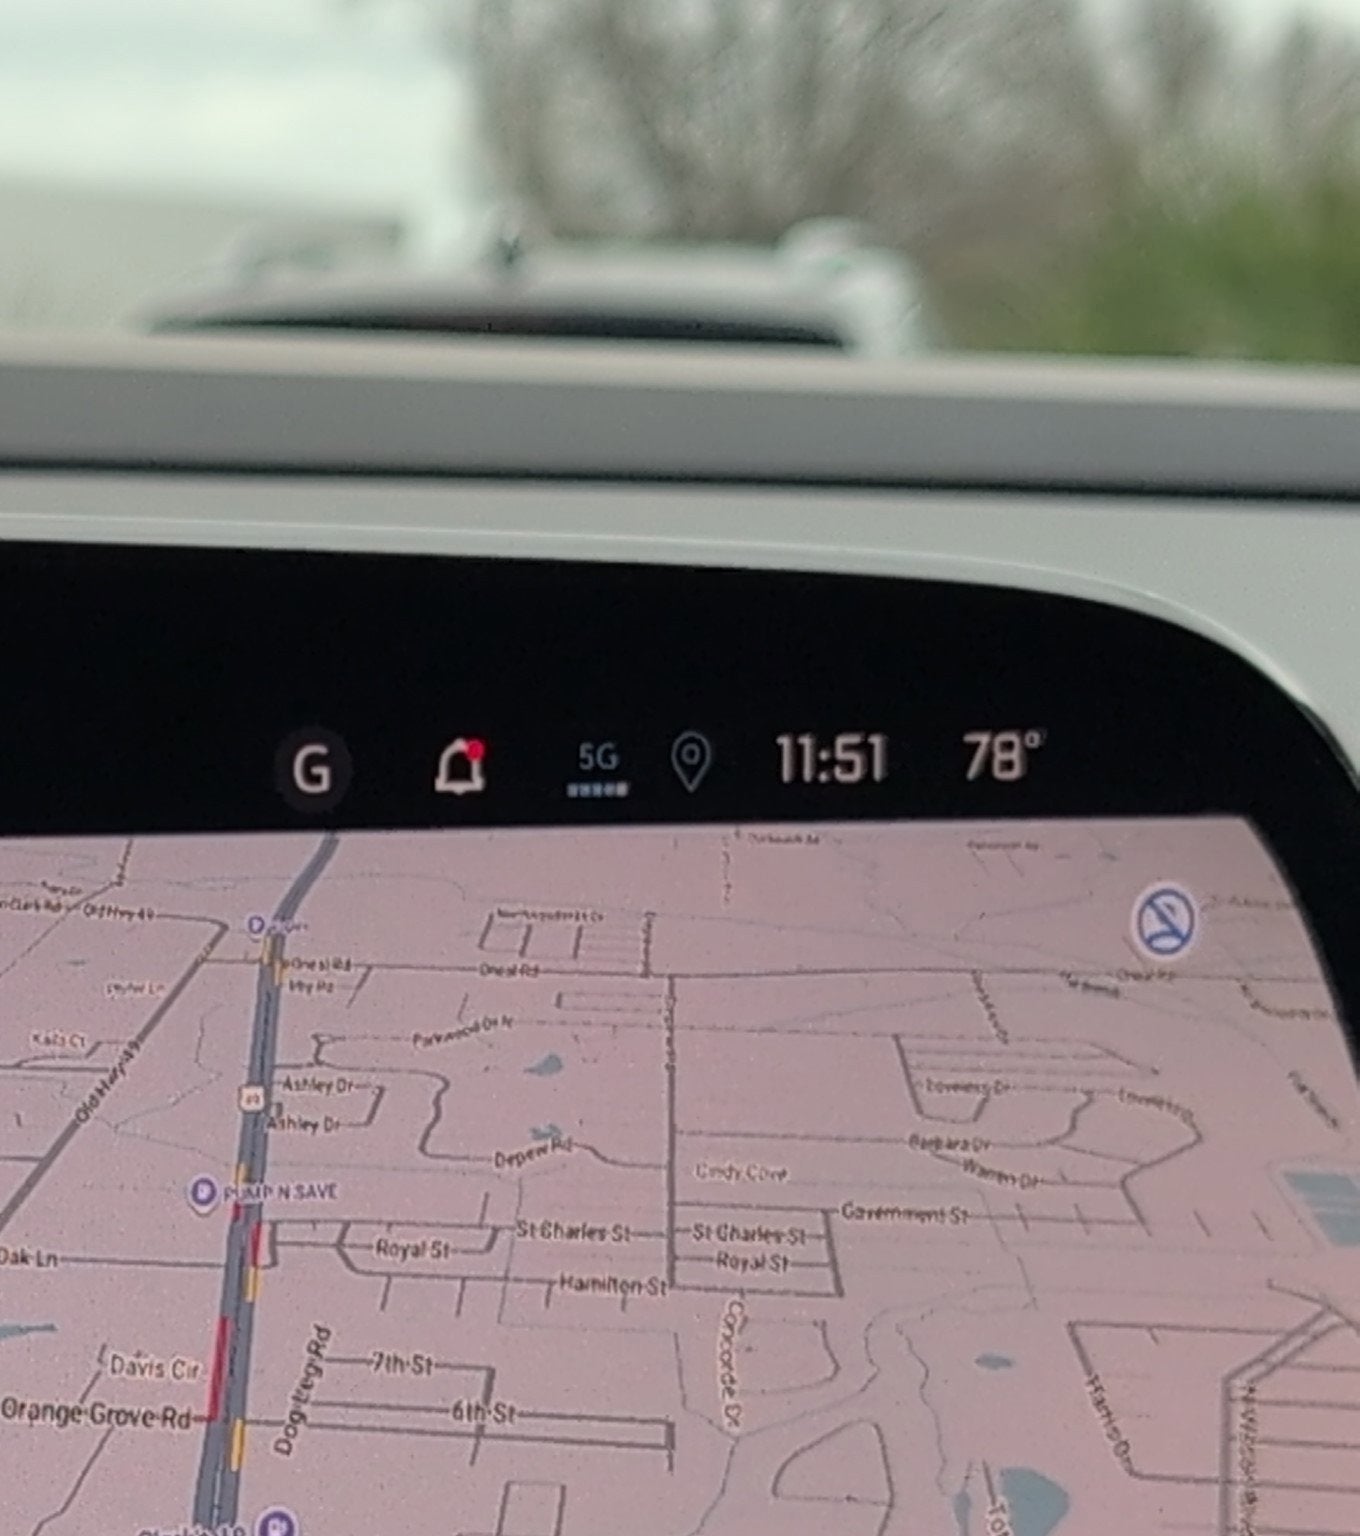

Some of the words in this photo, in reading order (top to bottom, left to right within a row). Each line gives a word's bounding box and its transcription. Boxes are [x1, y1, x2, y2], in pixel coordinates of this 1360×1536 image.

[578, 742, 620, 772] 5G
[776, 731, 888, 784] 11:51
[963, 730, 1044, 782] 78°
[293, 745, 331, 795] G
[282, 1078, 333, 1095] Ashley
[336, 1079, 354, 1093] Dr
[76, 1093, 100, 1123] Old
[267, 1115, 318, 1133] Ashley
[323, 1118, 340, 1131] Dr
[551, 1136, 574, 1153] Rd
[224, 1184, 273, 1202] PUMP
[277, 1184, 291, 1199] N
[295, 1183, 338, 1200] SAVE
[949, 1207, 971, 1225] St
[516, 1221, 535, 1238] St
[537, 1220, 607, 1242] Charles
[610, 1224, 631, 1242] St
[692, 1225, 712, 1242] St
[715, 1224, 782, 1245] Charles
[786, 1227, 808, 1245] St
[34, 1250, 59, 1268] Ln
[375, 1240, 427, 1260] Royal
[429, 1240, 451, 1259] St
[715, 1252, 767, 1275] Royal
[768, 1253, 790, 1273] St
[559, 1274, 641, 1296] Hamilton
[645, 1276, 668, 1296] St
[110, 1354, 165, 1378] Davis
[371, 1351, 403, 1374] 7th
[407, 1353, 434, 1375] St
[274, 1406, 307, 1457] Dog
[308, 1324, 333, 1363] Rd
[0, 1395, 85, 1426] Orange
[88, 1403, 156, 1425] Grove
[159, 1406, 192, 1429] Rd
[451, 1400, 487, 1422] 6th
[491, 1402, 517, 1423] St
